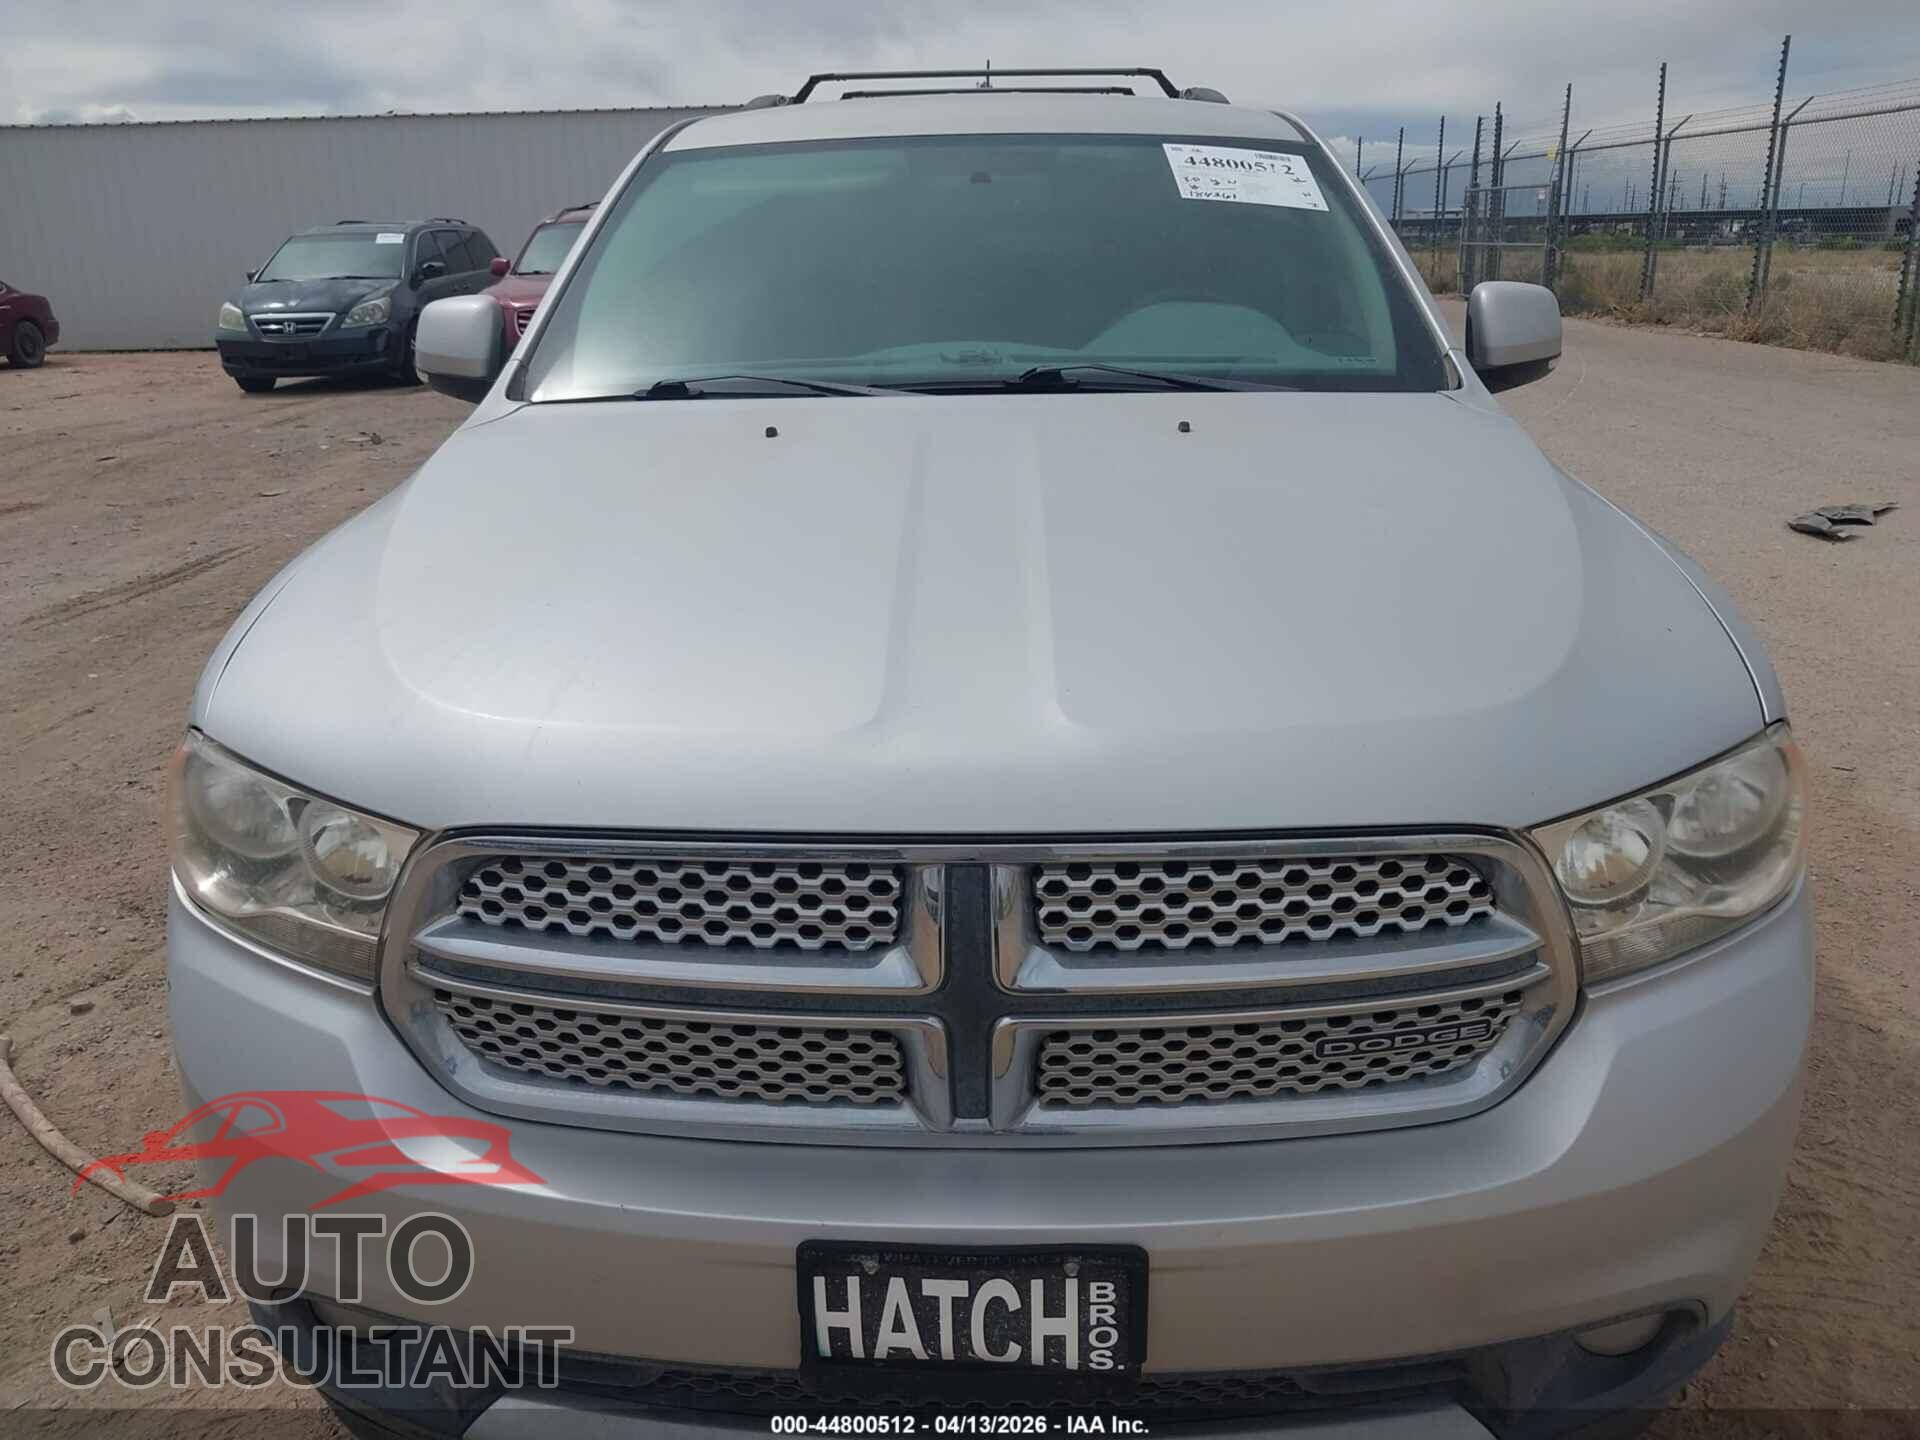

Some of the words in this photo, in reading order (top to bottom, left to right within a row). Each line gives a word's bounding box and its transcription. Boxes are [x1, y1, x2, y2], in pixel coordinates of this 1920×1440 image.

[1184, 155, 1296, 176] 44800512
[1322, 1023, 1490, 1056] DODGE
[812, 1275, 1079, 1371] HATCH
[1088, 1281, 1126, 1371] BROS.
